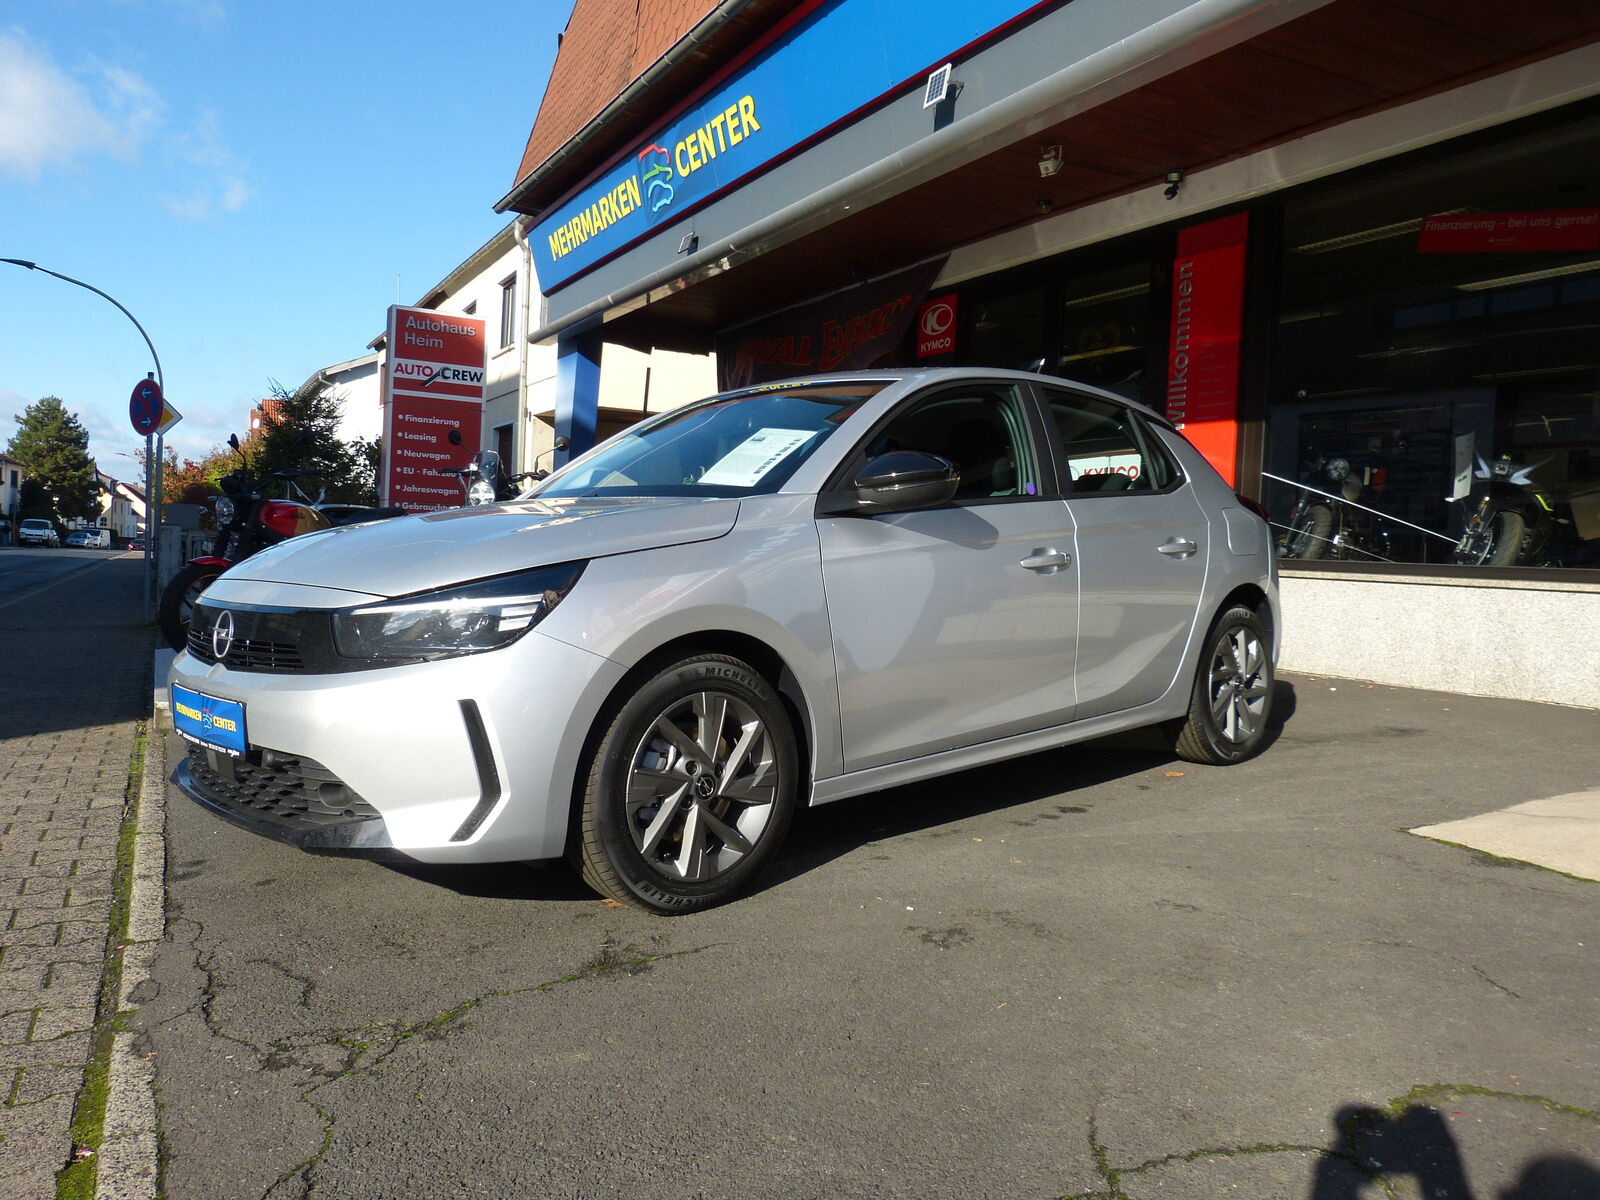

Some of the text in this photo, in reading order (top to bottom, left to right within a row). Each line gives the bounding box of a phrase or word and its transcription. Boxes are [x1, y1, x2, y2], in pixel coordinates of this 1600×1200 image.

[548, 95, 761, 262] MEHRMARKEN CENTER
[1425, 219, 1495, 232] Finanzierung
[1508, 215, 1527, 228] bei
[1530, 216, 1551, 227] uns
[1554, 213, 1598, 229] gerne!
[405, 316, 476, 337] Autohaus
[404, 332, 443, 349] Heim
[920, 337, 951, 353] KYMCO
[405, 414, 460, 428] Finanzierung
[404, 432, 437, 444] Leasing
[403, 450, 451, 461] Neuwagen
[403, 467, 415, 475] EU
[402, 484, 459, 496] Jahreswagen
[213, 715, 237, 732] CENTER
